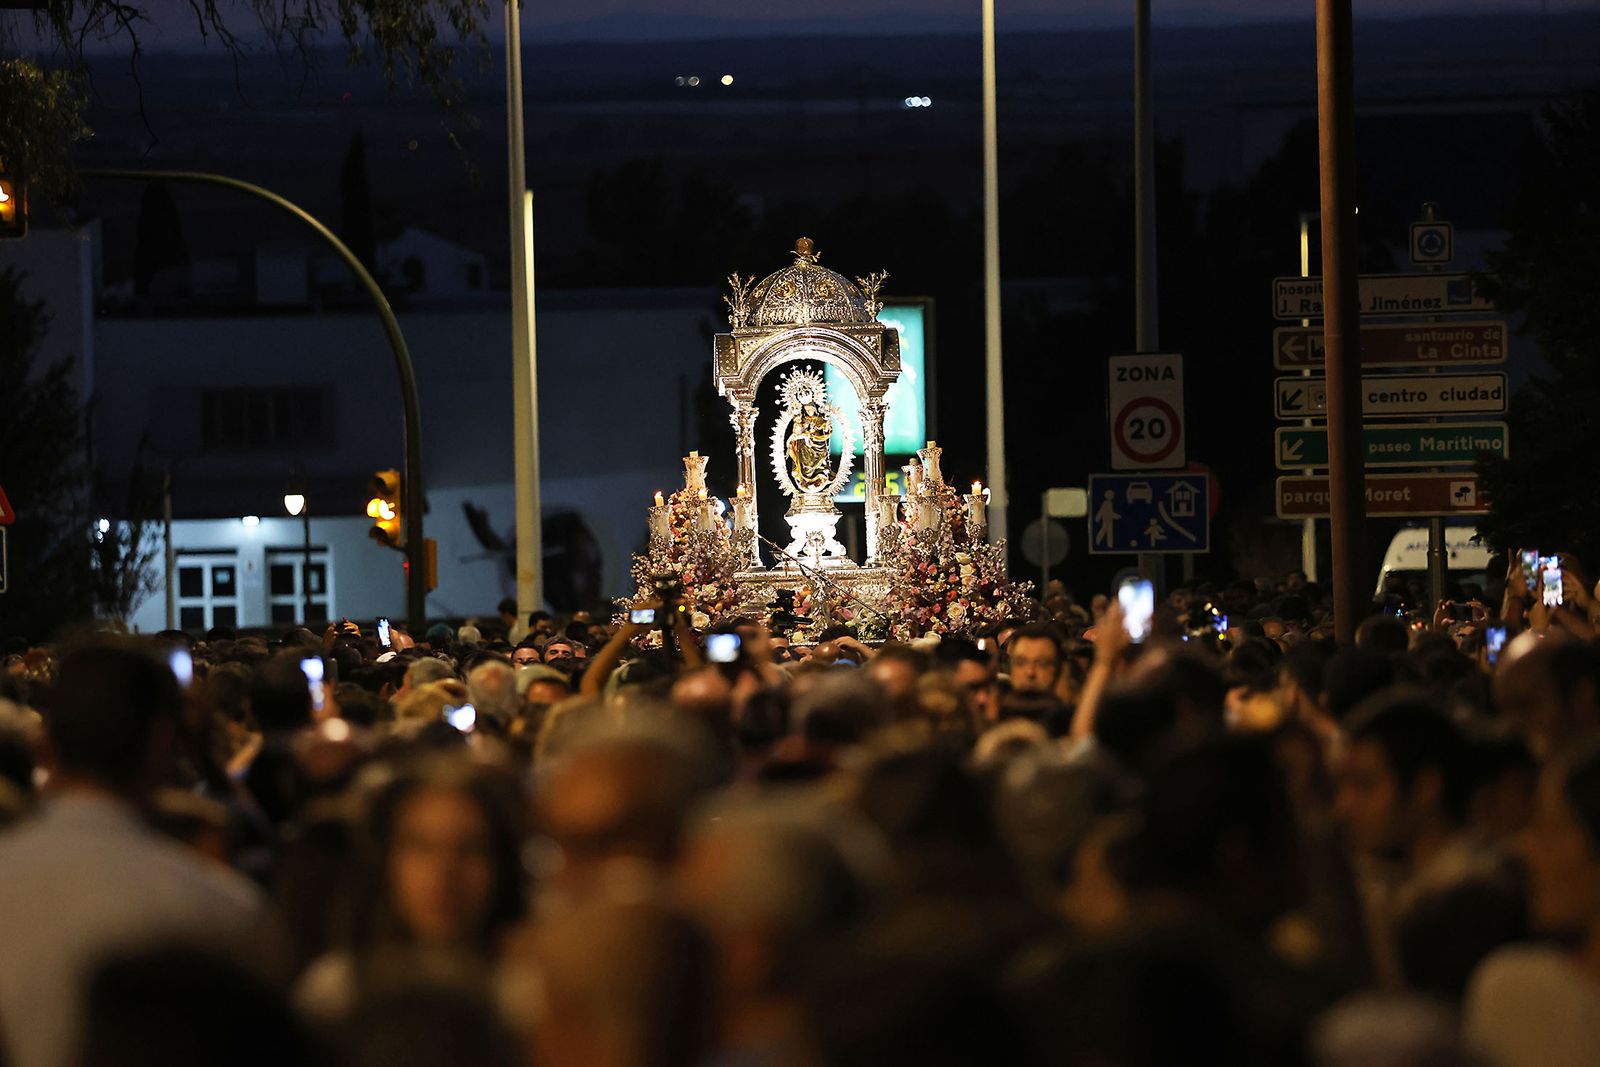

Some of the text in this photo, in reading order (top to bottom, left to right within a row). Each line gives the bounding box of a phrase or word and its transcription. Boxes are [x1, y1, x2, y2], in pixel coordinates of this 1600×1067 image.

[1280, 299, 1293, 313] J.
[1369, 295, 1442, 311] Jiménez
[1405, 329, 1500, 342] santuario de
[1417, 344, 1500, 359] La Cinta
[1116, 365, 1176, 382] ZONA
[1368, 387, 1501, 403] centro ciudad
[1129, 418, 1166, 440] 20
[1368, 442, 1412, 455] paseo
